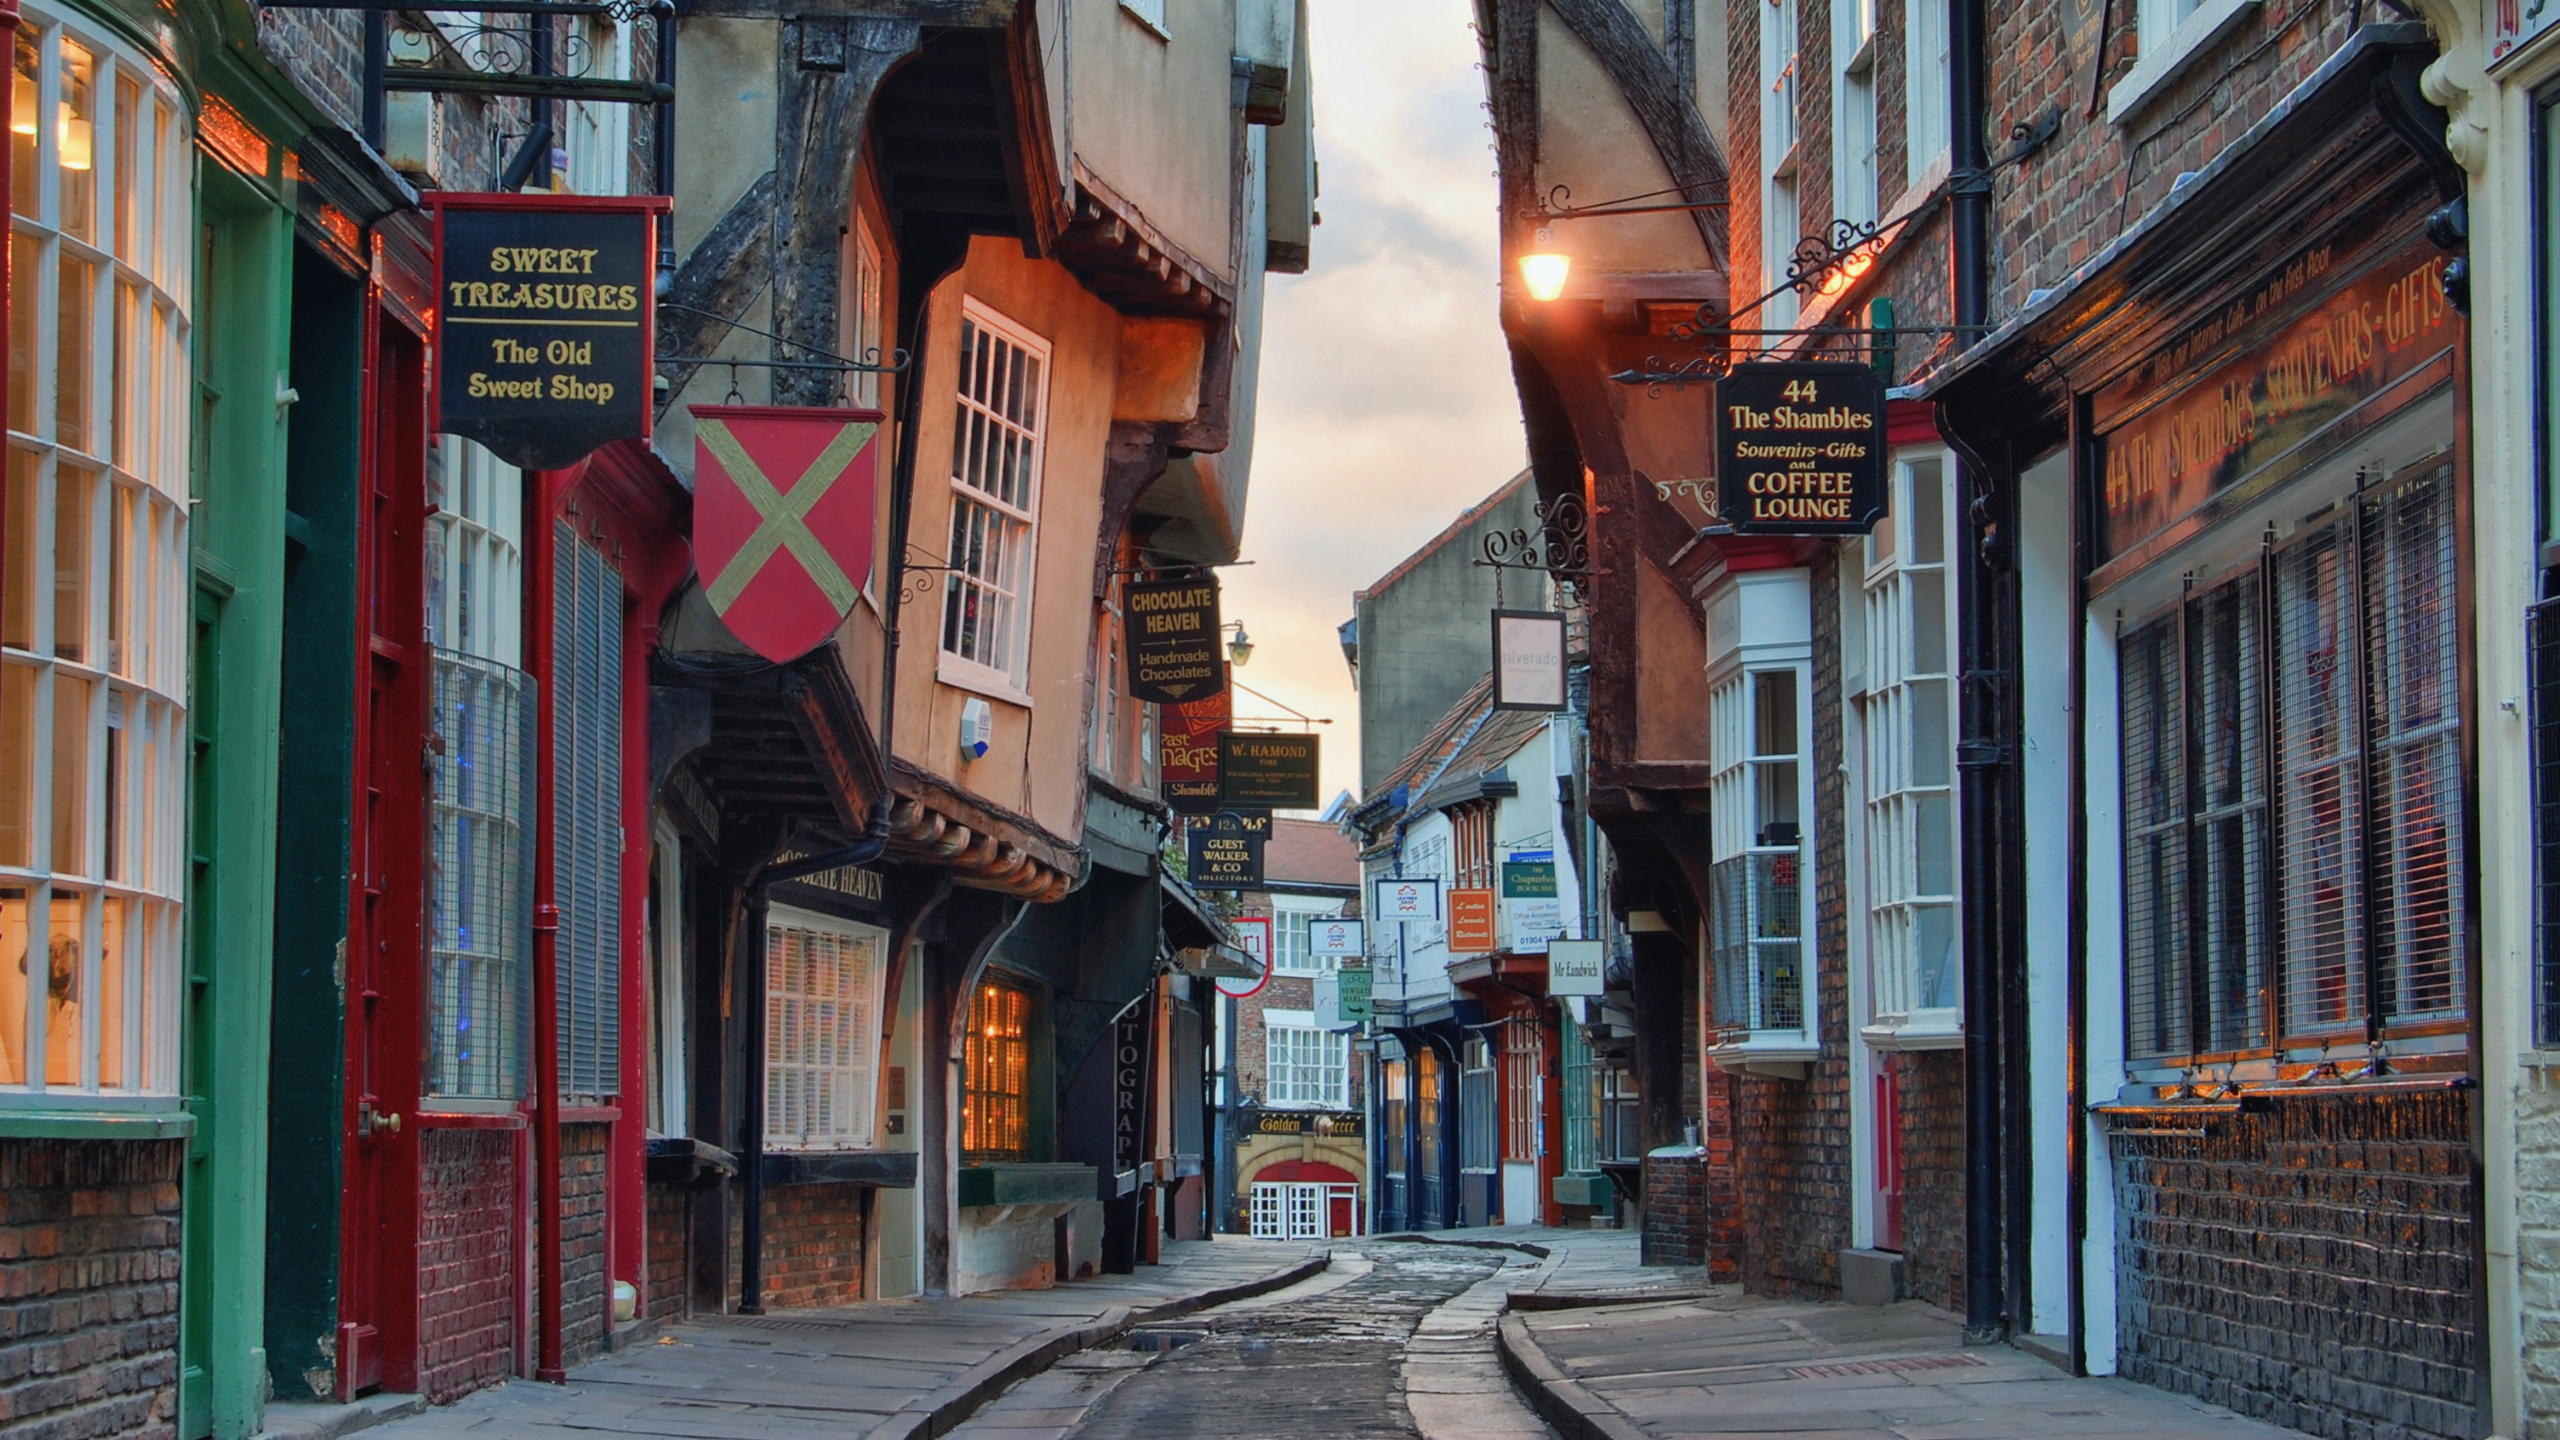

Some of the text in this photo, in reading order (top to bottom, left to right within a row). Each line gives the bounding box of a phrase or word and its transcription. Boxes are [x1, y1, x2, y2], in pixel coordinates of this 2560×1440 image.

[1537, 229, 1547, 242] 3
[490, 247, 599, 275] SWEET
[449, 281, 639, 312] TREASURES
[2190, 316, 2223, 358] Internet
[2255, 291, 2267, 313] on
[2269, 276, 2283, 305] the
[492, 339, 592, 366] The Old
[468, 373, 614, 405] Sweet Shop
[1783, 379, 1818, 403] 44
[1729, 406, 1873, 430] The Shambles
[2106, 443, 2128, 509] 44
[2132, 432, 2162, 497] The
[2170, 379, 2255, 478] Shambles
[1789, 460, 1815, 470] and
[1748, 472, 1853, 495] COFFEE
[1754, 498, 1852, 519] LOUNGE
[1131, 588, 1212, 612] CHOCOLATE
[1146, 612, 1201, 634] HEAVEN
[1139, 648, 1210, 666] Handmade
[1501, 649, 1559, 666] silverado
[1140, 665, 1212, 682] Chocolates
[1232, 743, 1307, 758] W. HAMOND
[1170, 783, 1219, 796] Shamble
[1208, 839, 1246, 850] GUEST
[1203, 850, 1250, 861] WALKER
[1212, 862, 1242, 872] & CO
[840, 864, 884, 902] HEAVEN
[1520, 936, 1542, 944] 01904
[1554, 961, 1565, 976] Mr
[1260, 1118, 1356, 1133] Golden leece
